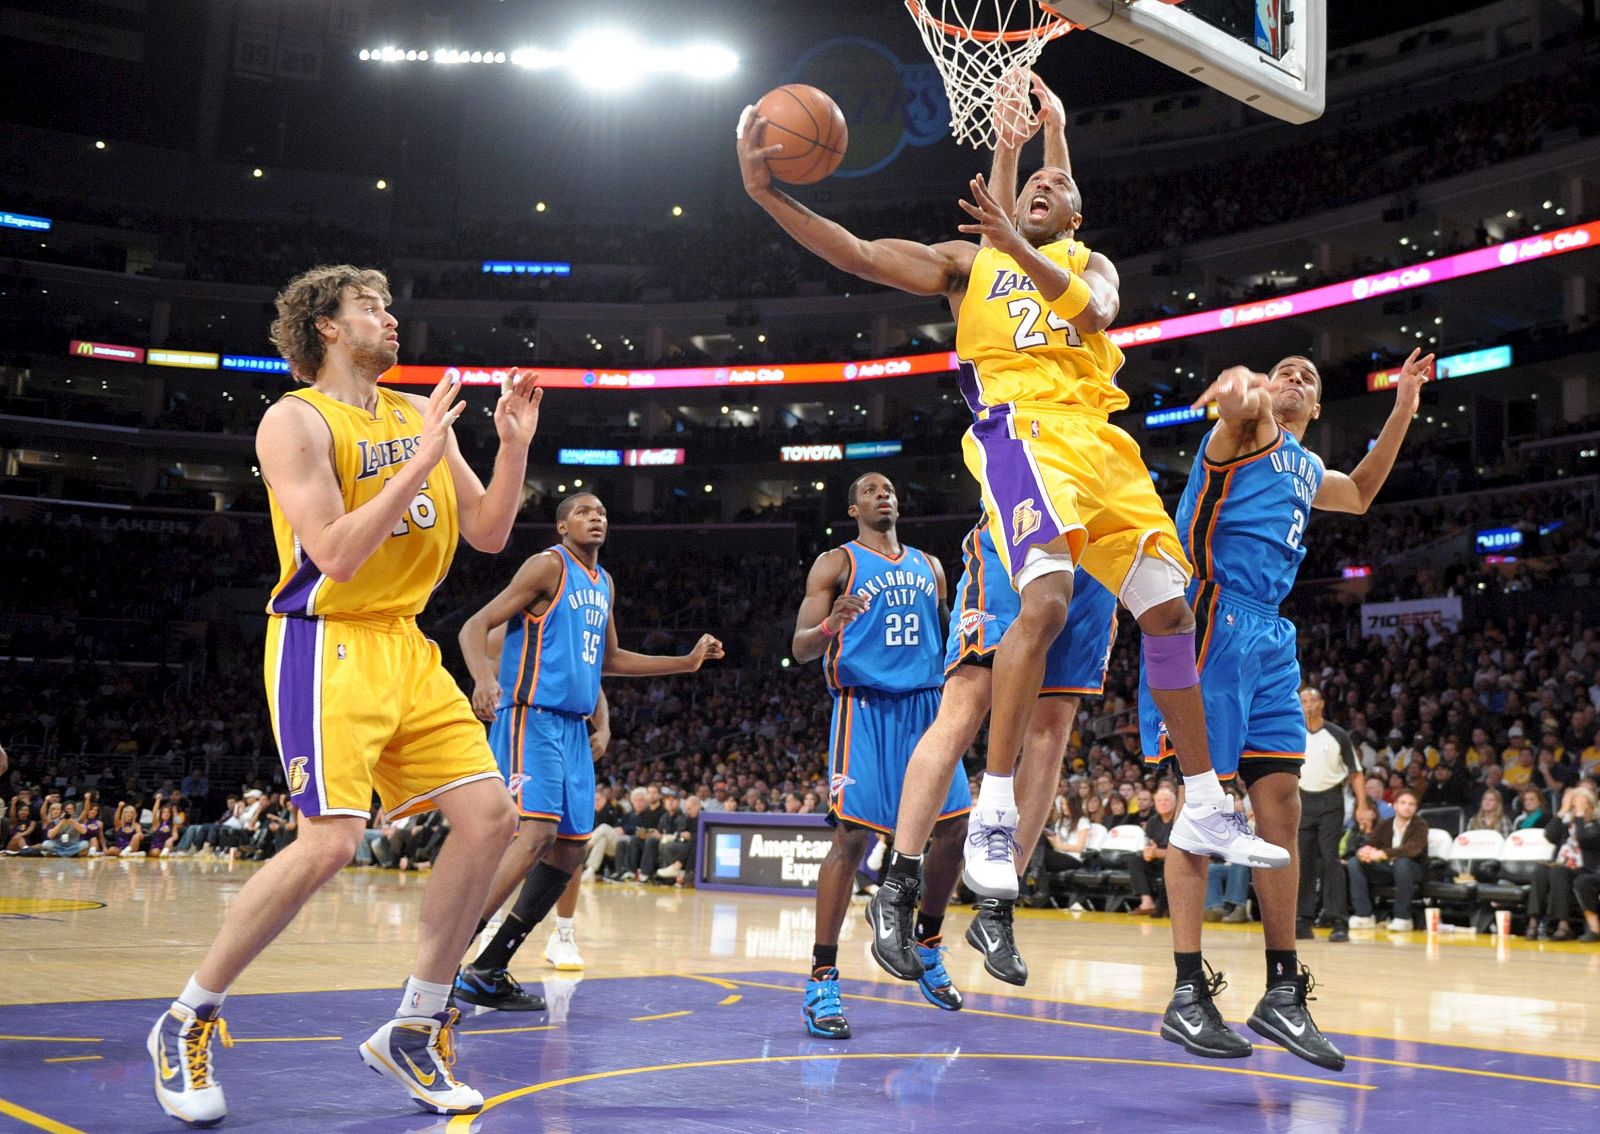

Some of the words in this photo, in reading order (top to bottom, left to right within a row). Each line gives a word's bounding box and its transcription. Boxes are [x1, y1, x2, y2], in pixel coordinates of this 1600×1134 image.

[1519, 240, 1552, 258] Auto
[1553, 230, 1589, 250] Club
[986, 269, 1039, 301] LAK
[1370, 276, 1399, 293] Auto
[1400, 268, 1431, 286] Club
[1236, 307, 1264, 322] Auto
[1264, 300, 1293, 316] Club
[1007, 297, 1082, 352] 24
[1110, 331, 1135, 345] Auto
[1135, 326, 1162, 341] Club
[462, 371, 490, 383] Auto
[599, 373, 628, 386] Auto
[629, 373, 655, 386] Club
[729, 370, 756, 383] Auto
[757, 369, 784, 381] Club
[859, 363, 884, 377] Auto
[885, 360, 911, 374] Club
[781, 445, 843, 461] TOYOTA
[384, 478, 437, 537] 6
[1286, 509, 1304, 549] 2
[857, 570, 934, 601] OKLAHOMA
[885, 589, 916, 607] CITY
[585, 608, 604, 629] CITY
[885, 613, 919, 646] 22
[582, 630, 601, 665] 35
